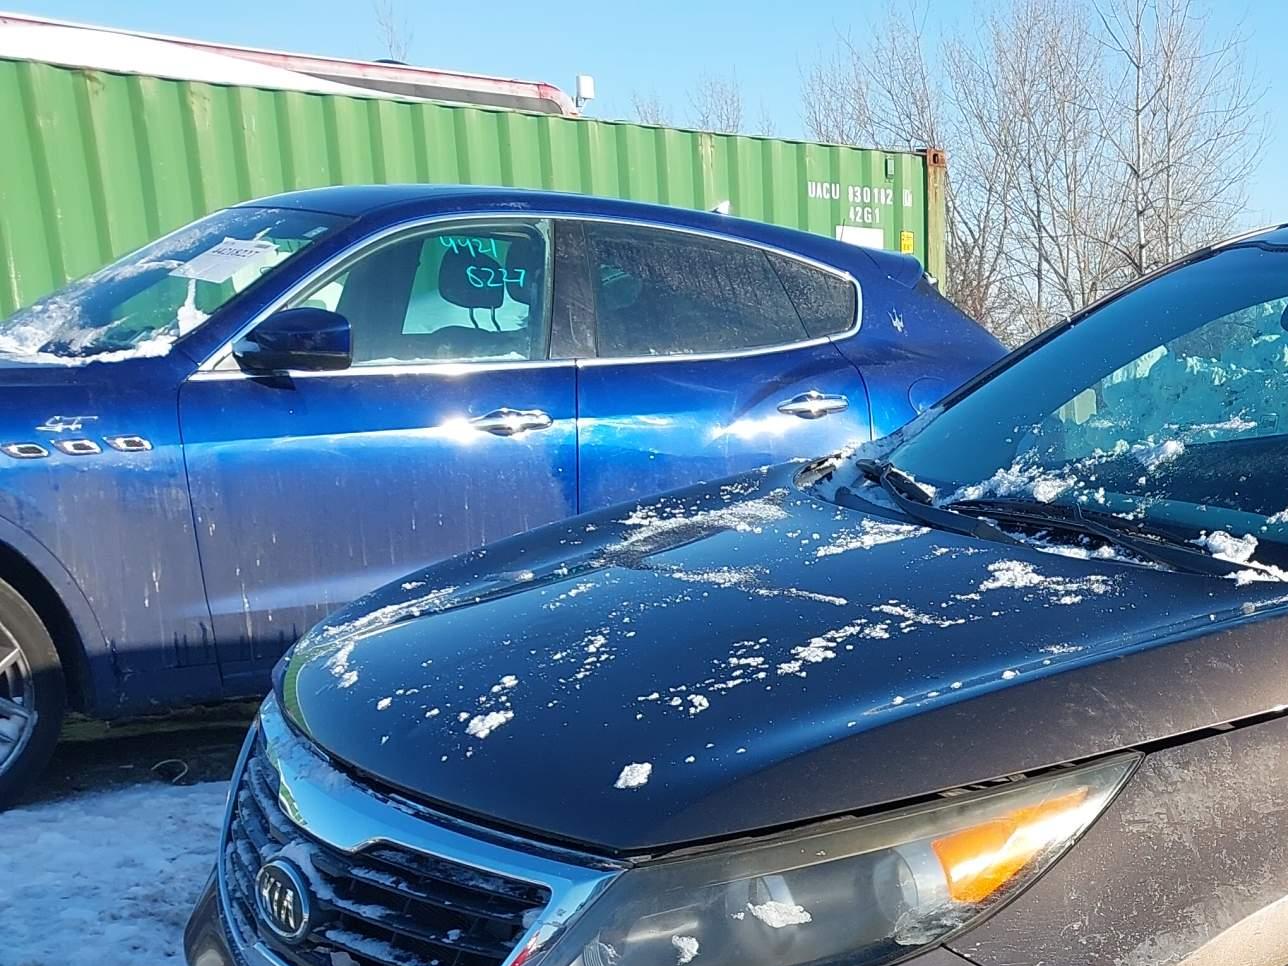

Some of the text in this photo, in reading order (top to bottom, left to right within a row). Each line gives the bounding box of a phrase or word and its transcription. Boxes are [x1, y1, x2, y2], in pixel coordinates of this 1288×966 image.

[808, 181, 840, 200] UACU
[849, 206, 880, 224] 42G1
[440, 236, 498, 258] 4421
[262, 871, 296, 929] KIA
